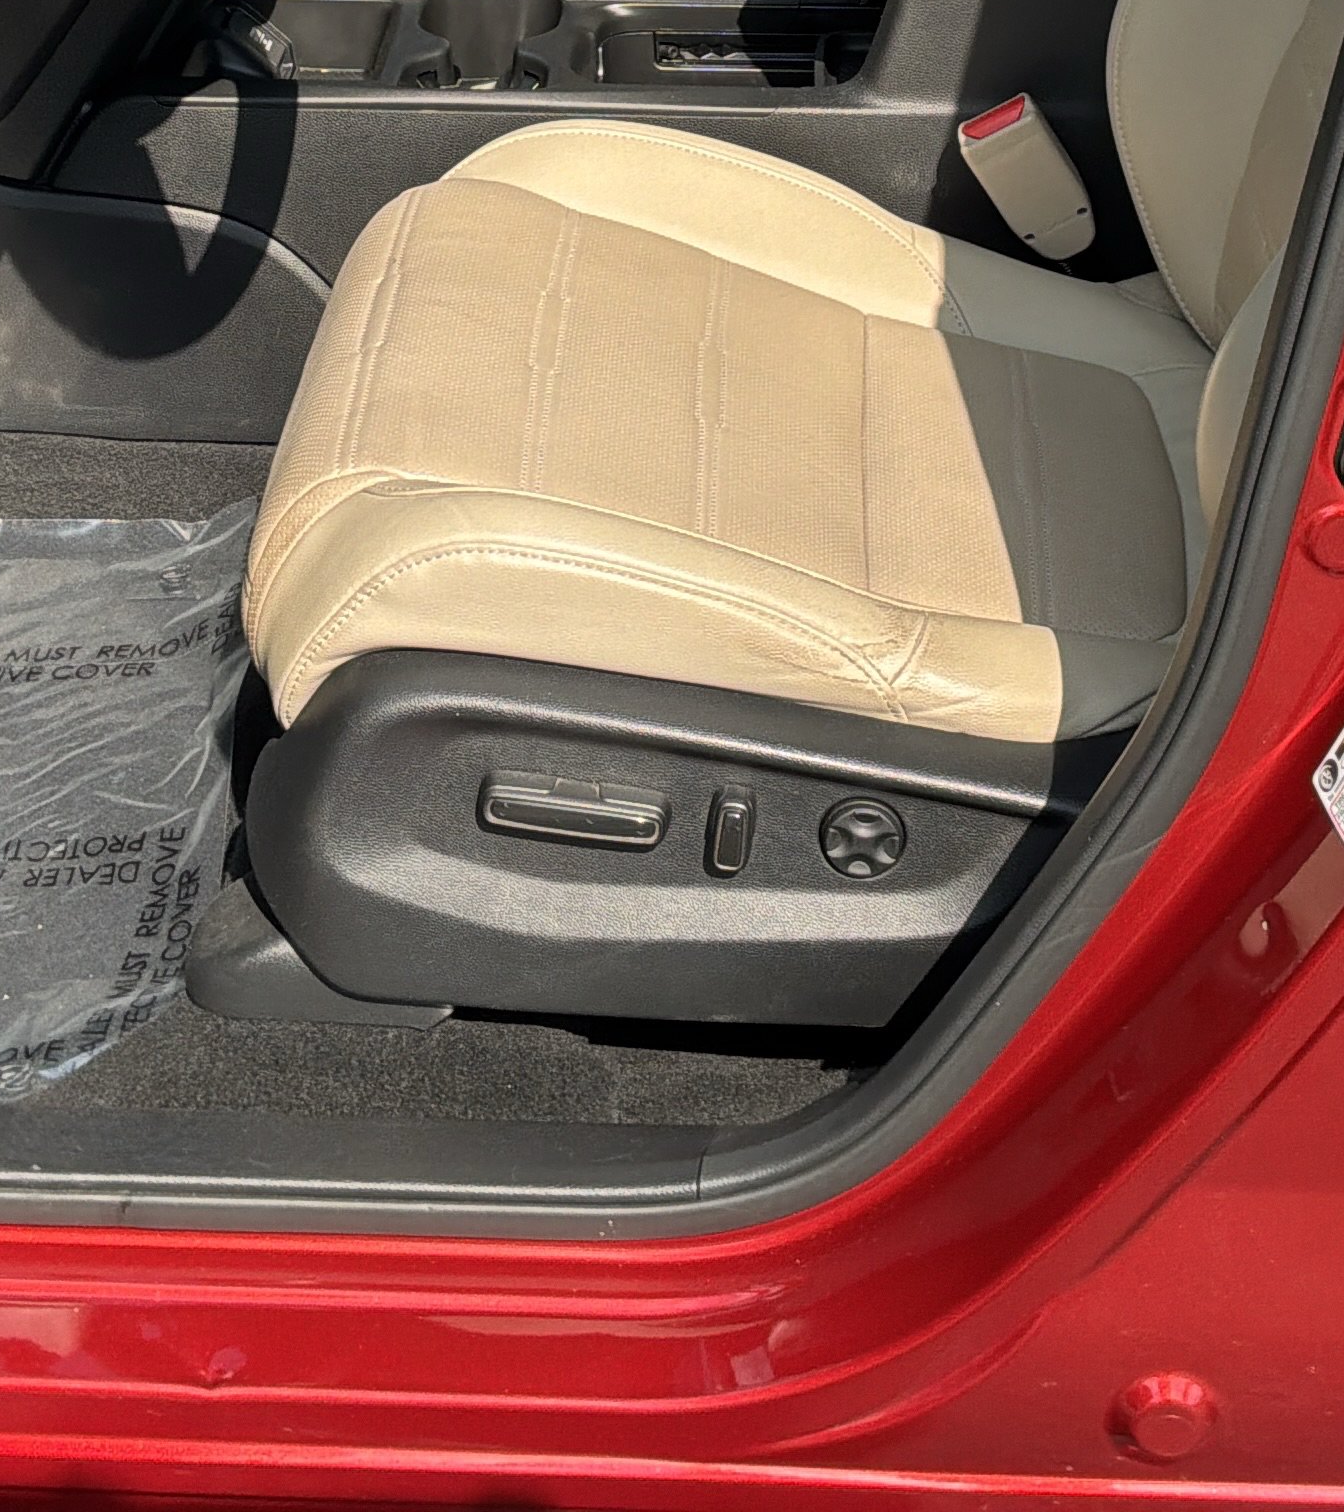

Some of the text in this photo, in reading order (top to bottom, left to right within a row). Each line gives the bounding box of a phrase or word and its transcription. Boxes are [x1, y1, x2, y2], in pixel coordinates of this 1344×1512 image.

[4, 643, 80, 663] MUST
[95, 617, 211, 661] REMOVE
[51, 659, 155, 682] COVER
[23, 860, 140, 887] DEALER
[106, 949, 151, 1000] MUST
[134, 825, 186, 939] REMOVE
[161, 864, 201, 962] COVER
